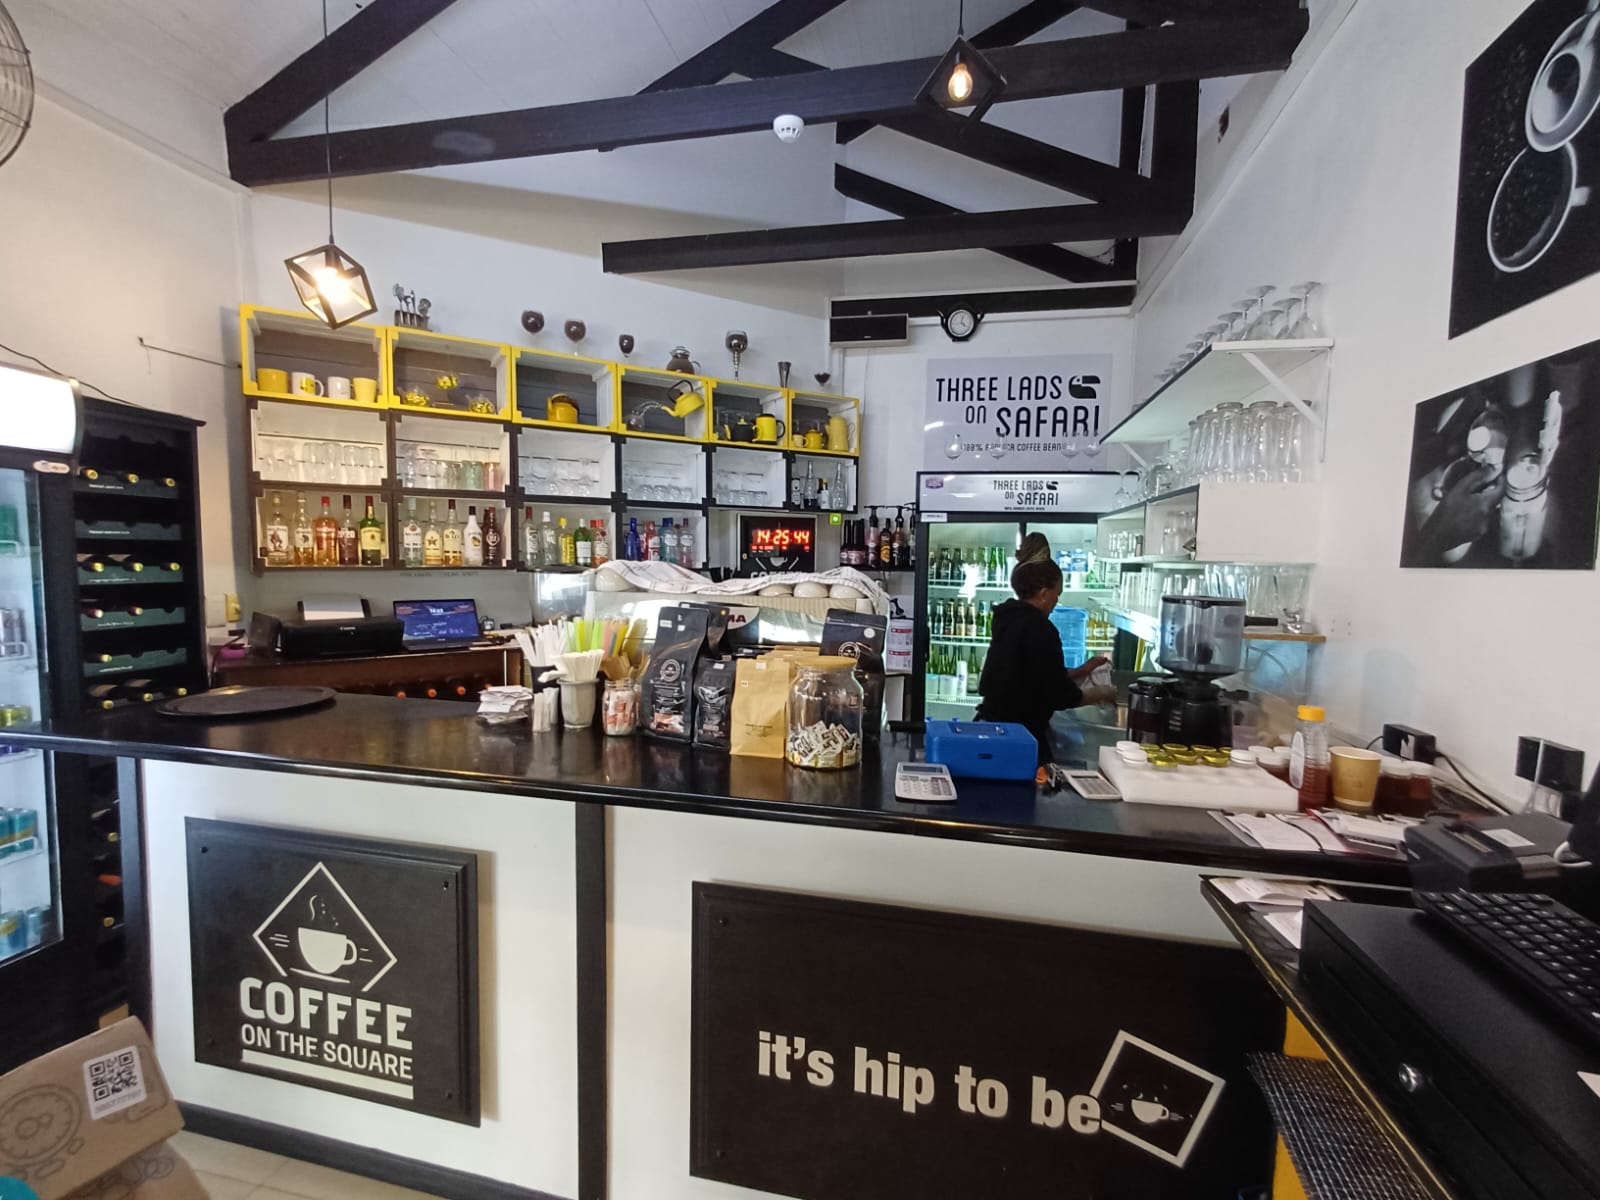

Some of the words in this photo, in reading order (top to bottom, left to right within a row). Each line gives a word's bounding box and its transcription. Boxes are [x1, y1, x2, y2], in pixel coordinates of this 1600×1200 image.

[936, 376, 998, 402] THREE
[1007, 375, 1063, 401] LADS
[995, 405, 1101, 438] SAFARI
[1016, 443, 1041, 452] COFFEE
[993, 480, 1018, 491] THREE
[1021, 480, 1044, 491] LADS
[1016, 492, 1059, 506] SAFARI
[240, 976, 413, 1051] COFFEE
[241, 1023, 272, 1049] ON
[276, 1030, 319, 1058] THE
[323, 1041, 414, 1080] SQUARE
[757, 1030, 835, 1087] it's
[853, 1046, 935, 1113] hip
[954, 1064, 1010, 1118] to
[1031, 1075, 1103, 1134] be
